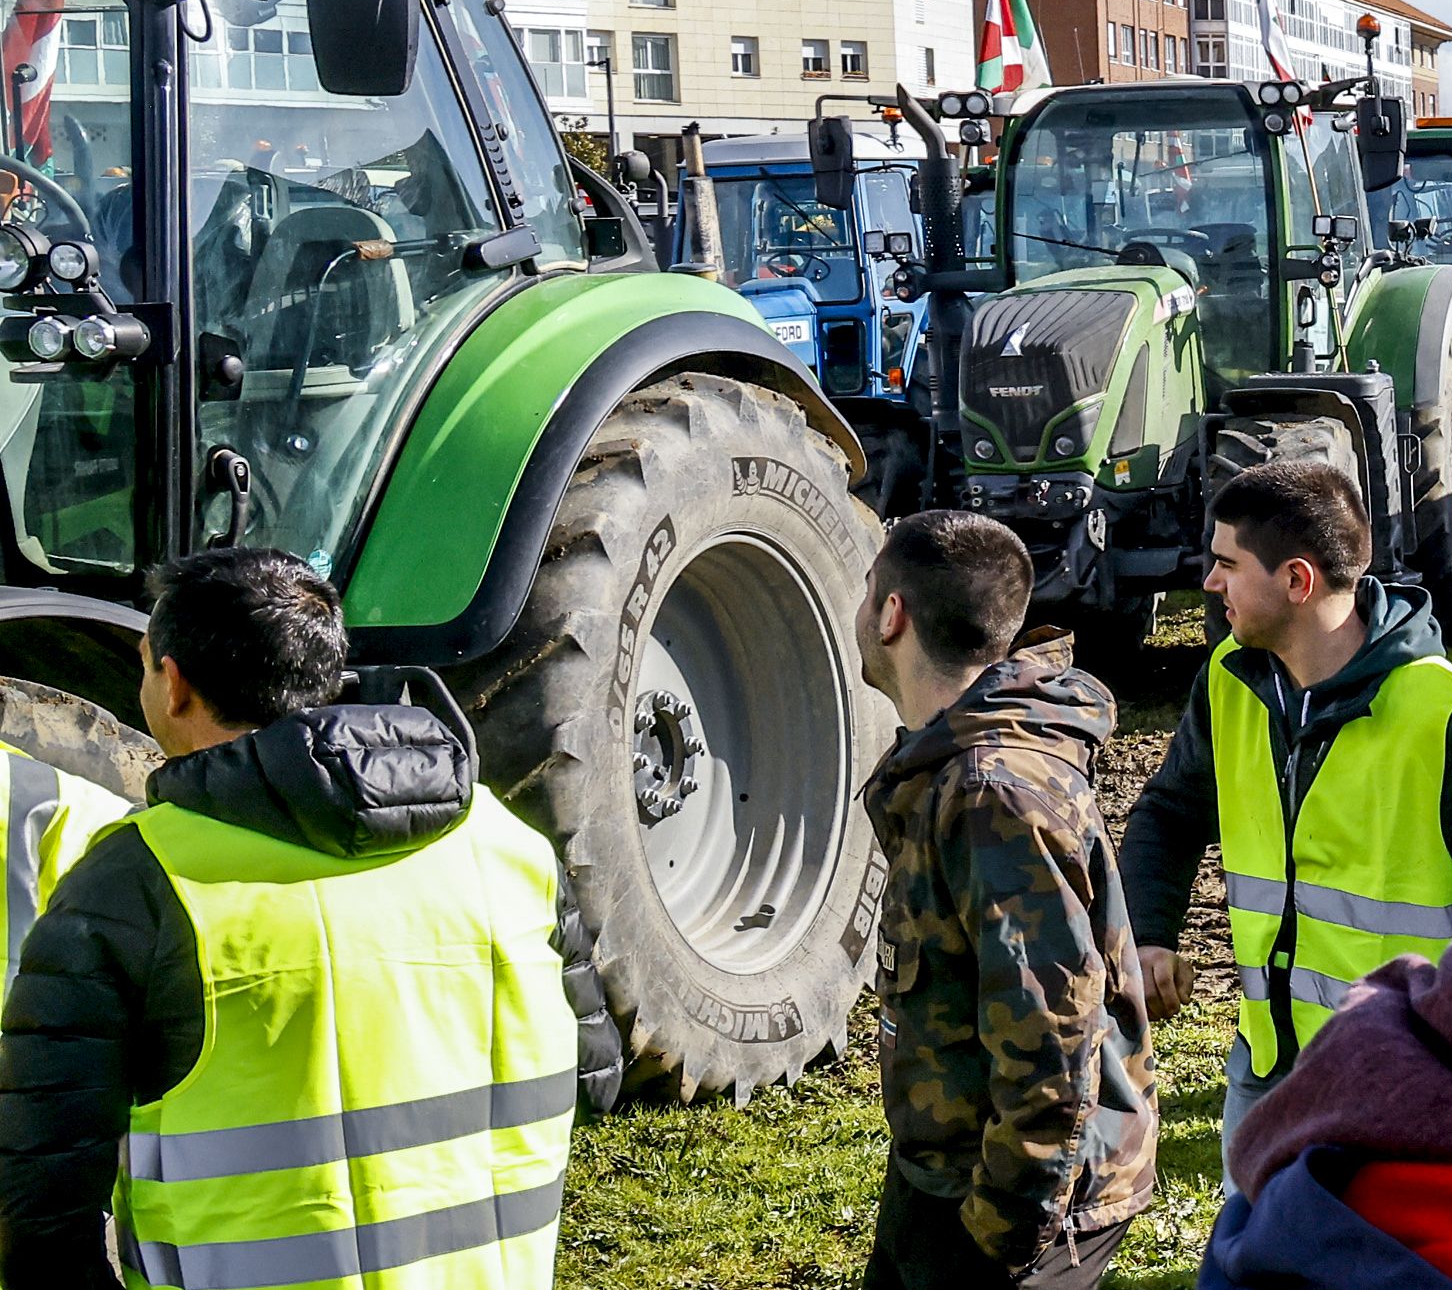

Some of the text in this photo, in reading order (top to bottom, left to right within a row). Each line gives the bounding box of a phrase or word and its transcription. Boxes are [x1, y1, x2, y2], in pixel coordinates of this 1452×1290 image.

[776, 325, 802, 340] FORD
[988, 385, 1044, 398] FENDT
[627, 583, 650, 622] R
[645, 528, 672, 582] 42
[852, 849, 890, 940] IBIB
